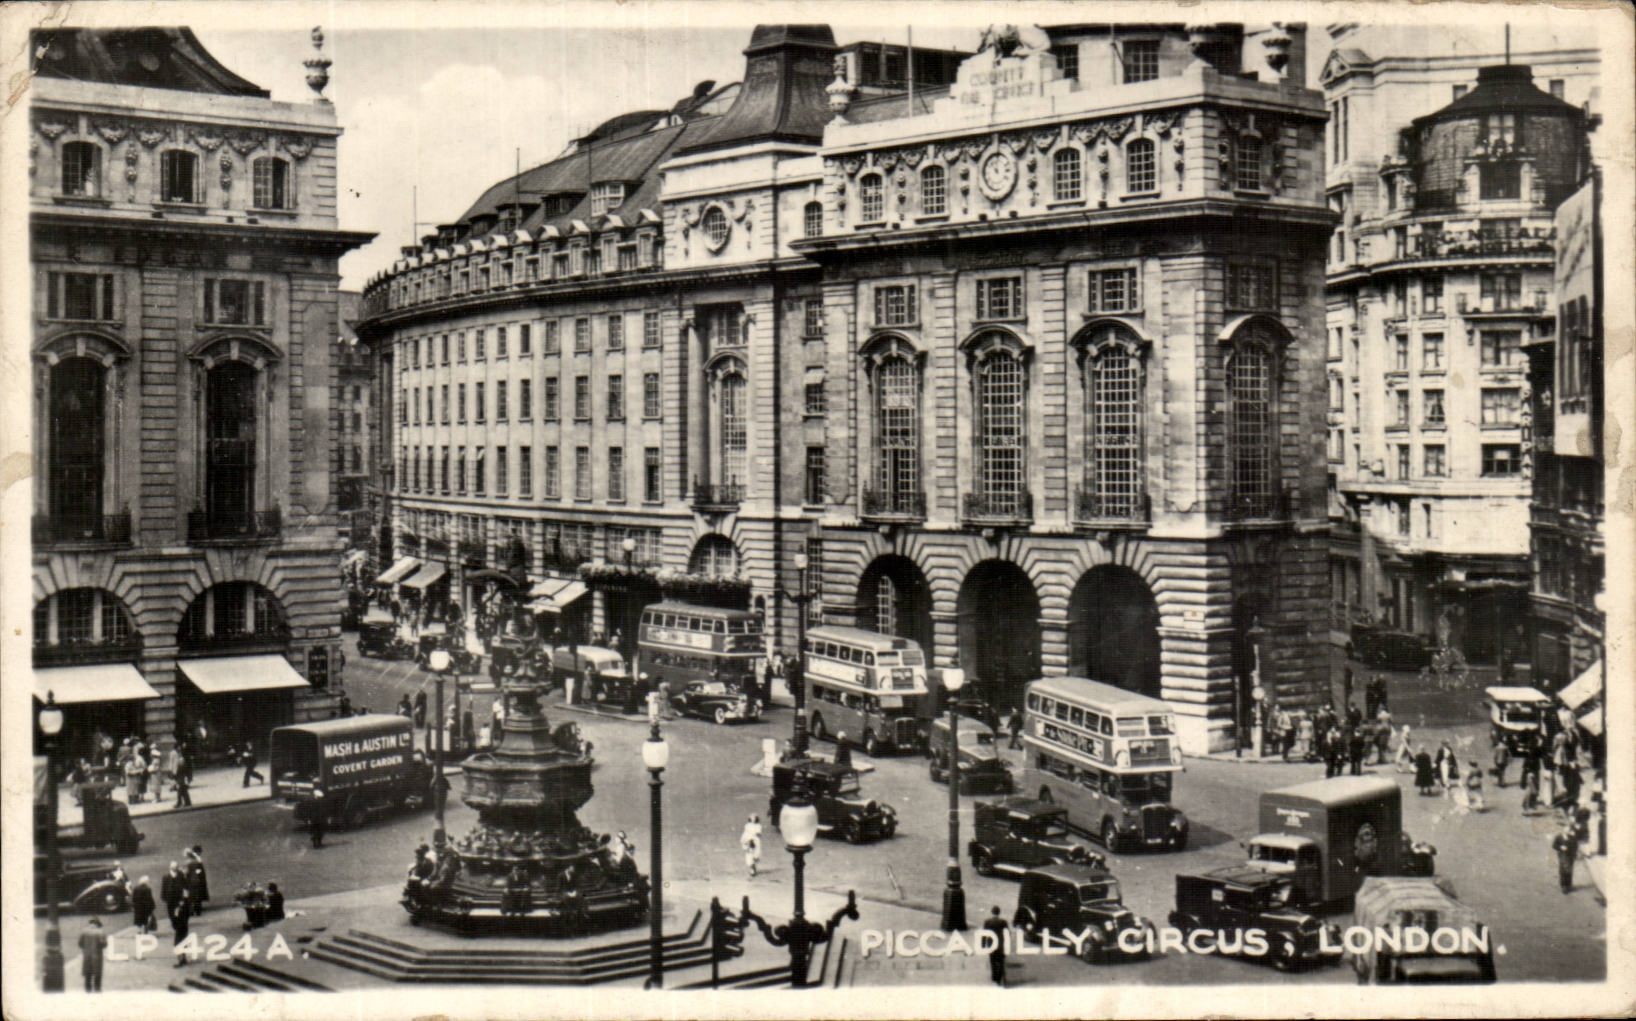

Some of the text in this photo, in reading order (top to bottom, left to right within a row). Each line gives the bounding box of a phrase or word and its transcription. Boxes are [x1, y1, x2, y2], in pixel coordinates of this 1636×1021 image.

[354, 743, 360, 754] &
[362, 735, 397, 752] AUSTIN
[333, 755, 403, 774] COVENT GARDEN
